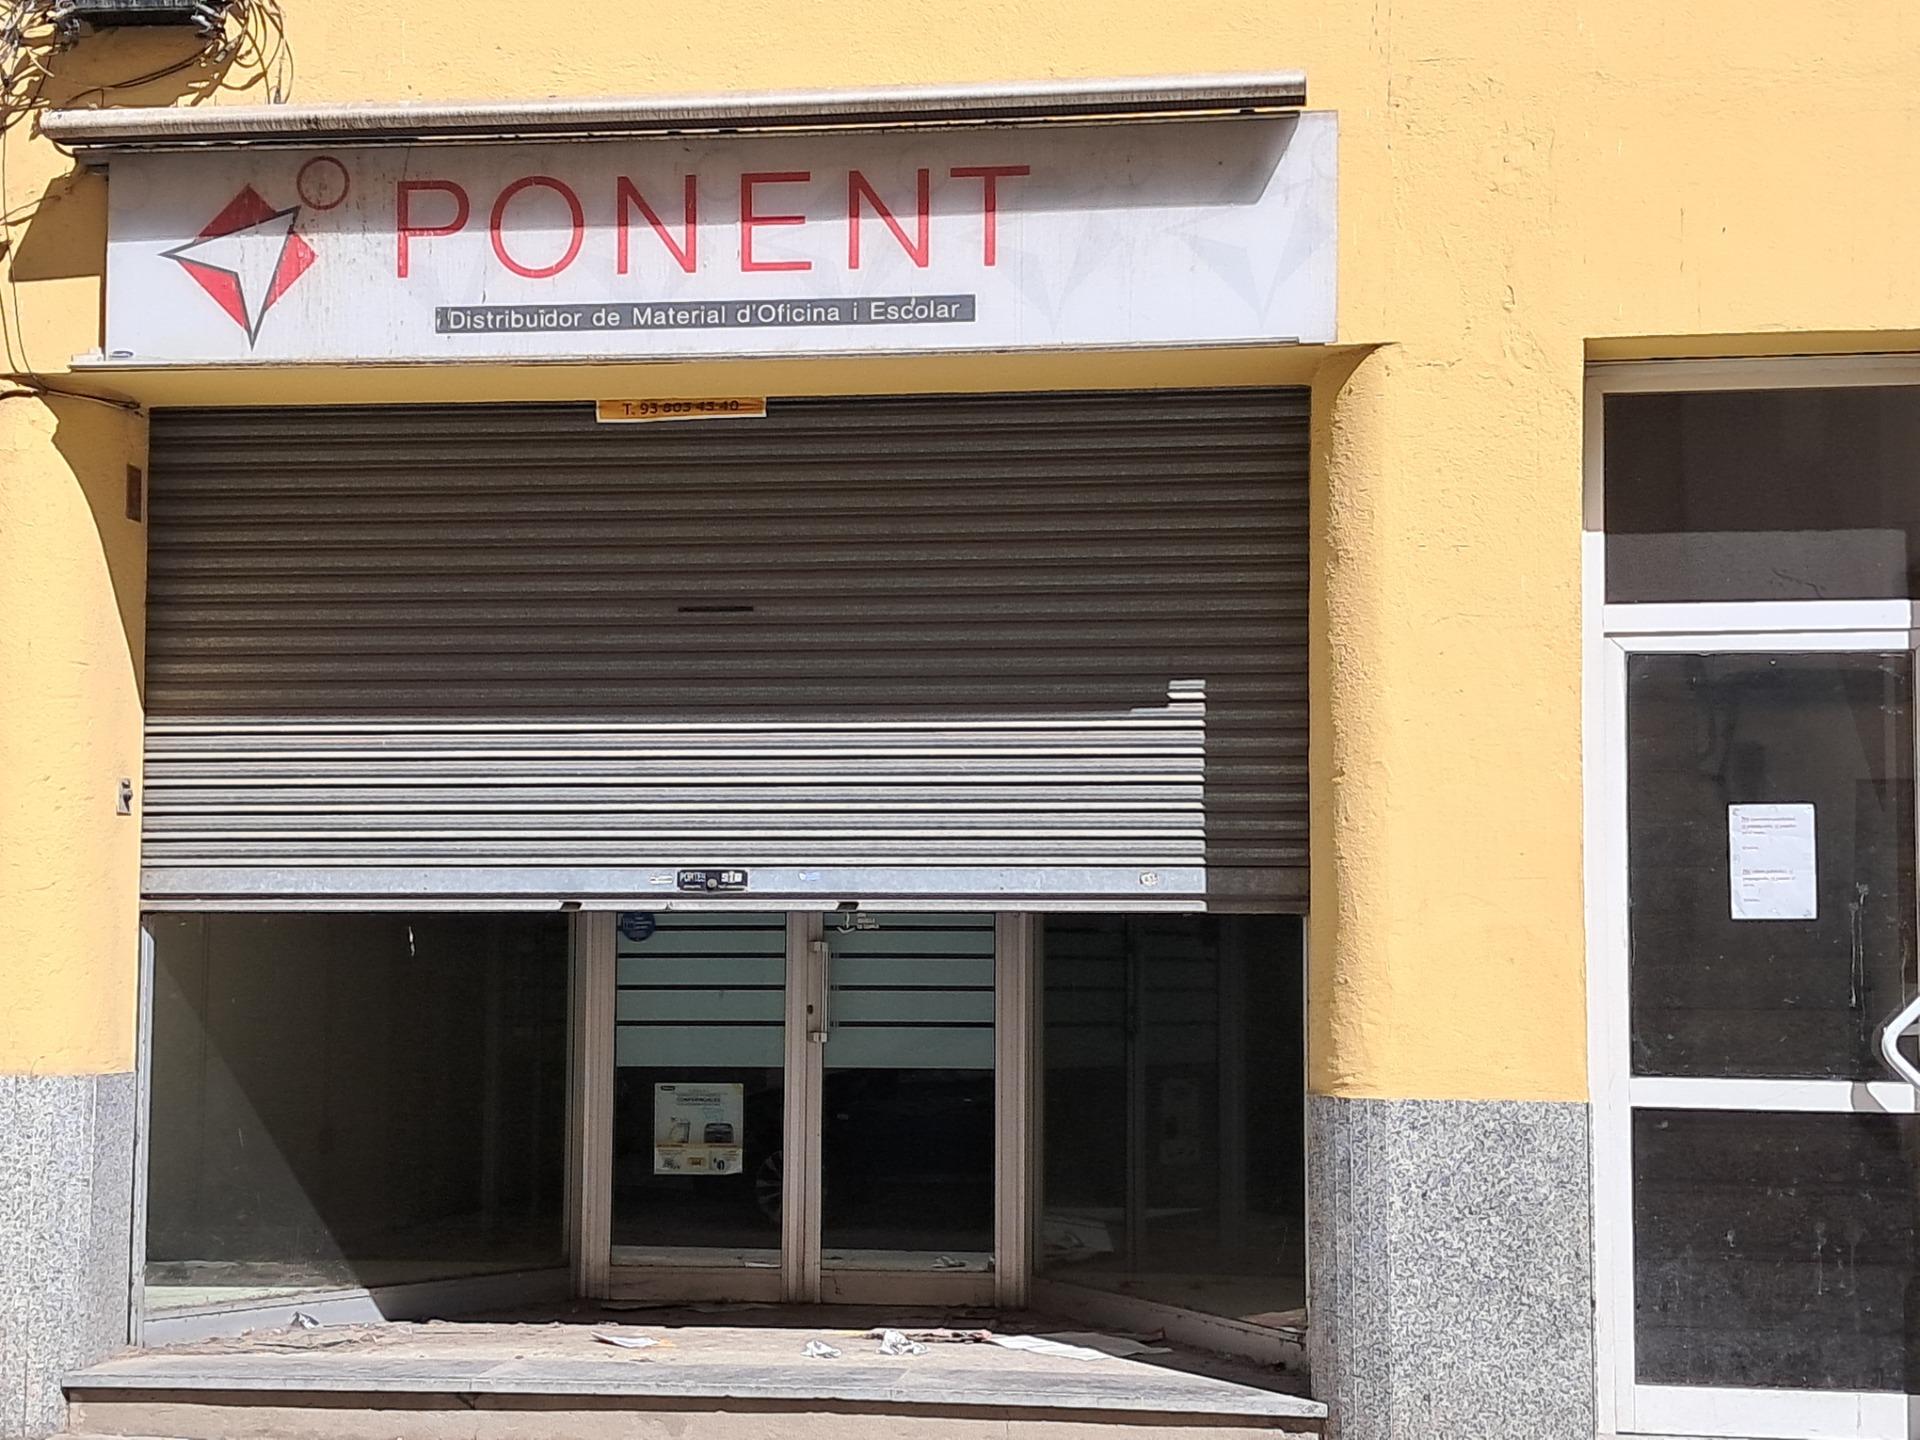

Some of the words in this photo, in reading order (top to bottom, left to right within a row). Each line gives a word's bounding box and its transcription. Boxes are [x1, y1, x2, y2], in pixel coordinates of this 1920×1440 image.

[396, 164, 1031, 279] PONENT
[592, 306, 621, 327] de
[632, 304, 726, 326] Material
[736, 302, 841, 324] d'Oficina
[852, 301, 859, 321] i
[870, 298, 961, 320] Escolar
[622, 402, 636, 416] T.
